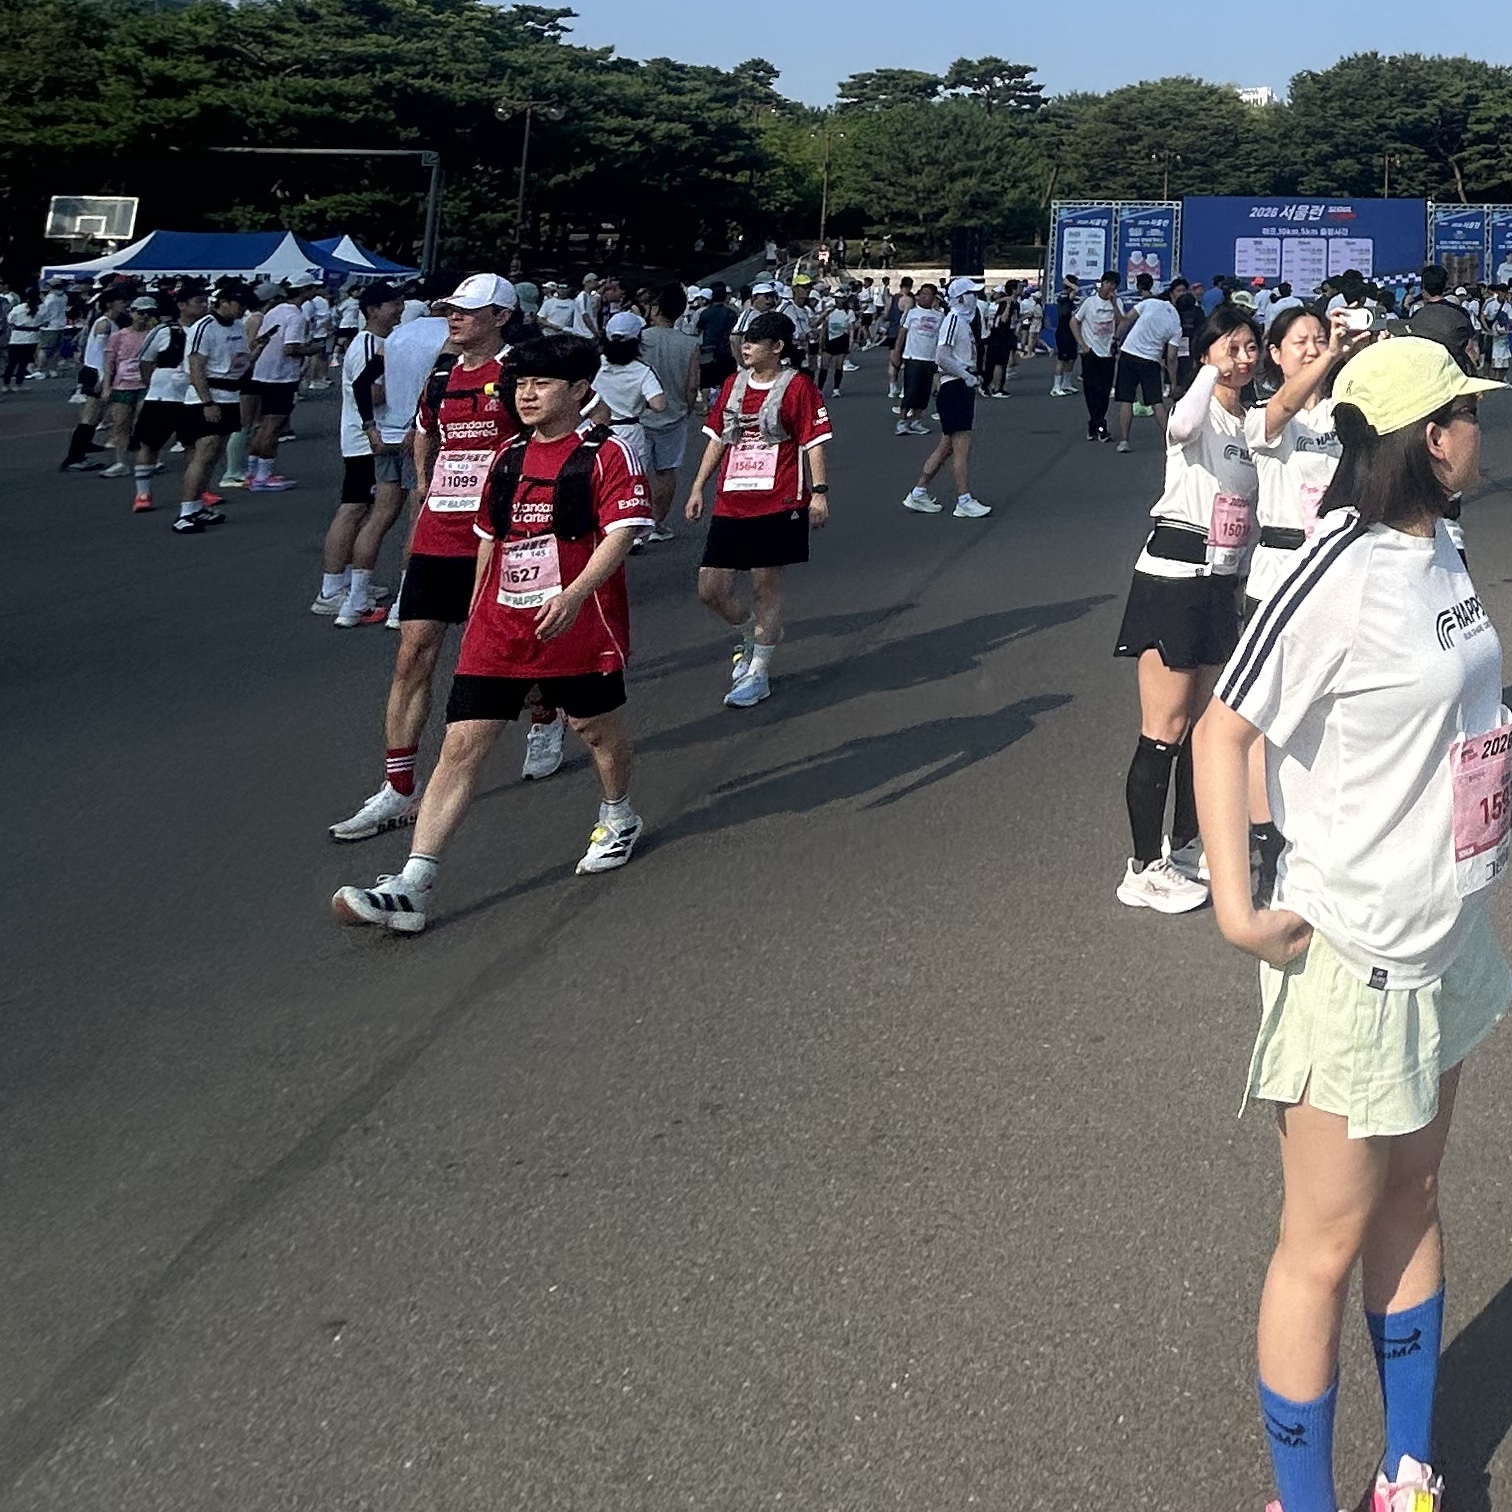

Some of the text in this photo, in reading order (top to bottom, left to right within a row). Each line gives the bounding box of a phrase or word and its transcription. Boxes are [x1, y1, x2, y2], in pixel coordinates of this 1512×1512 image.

[1279, 204, 1326, 221] 서울런
[446, 420, 495, 431] standard
[447, 428, 498, 440] chartered
[441, 475, 478, 488] 11099
